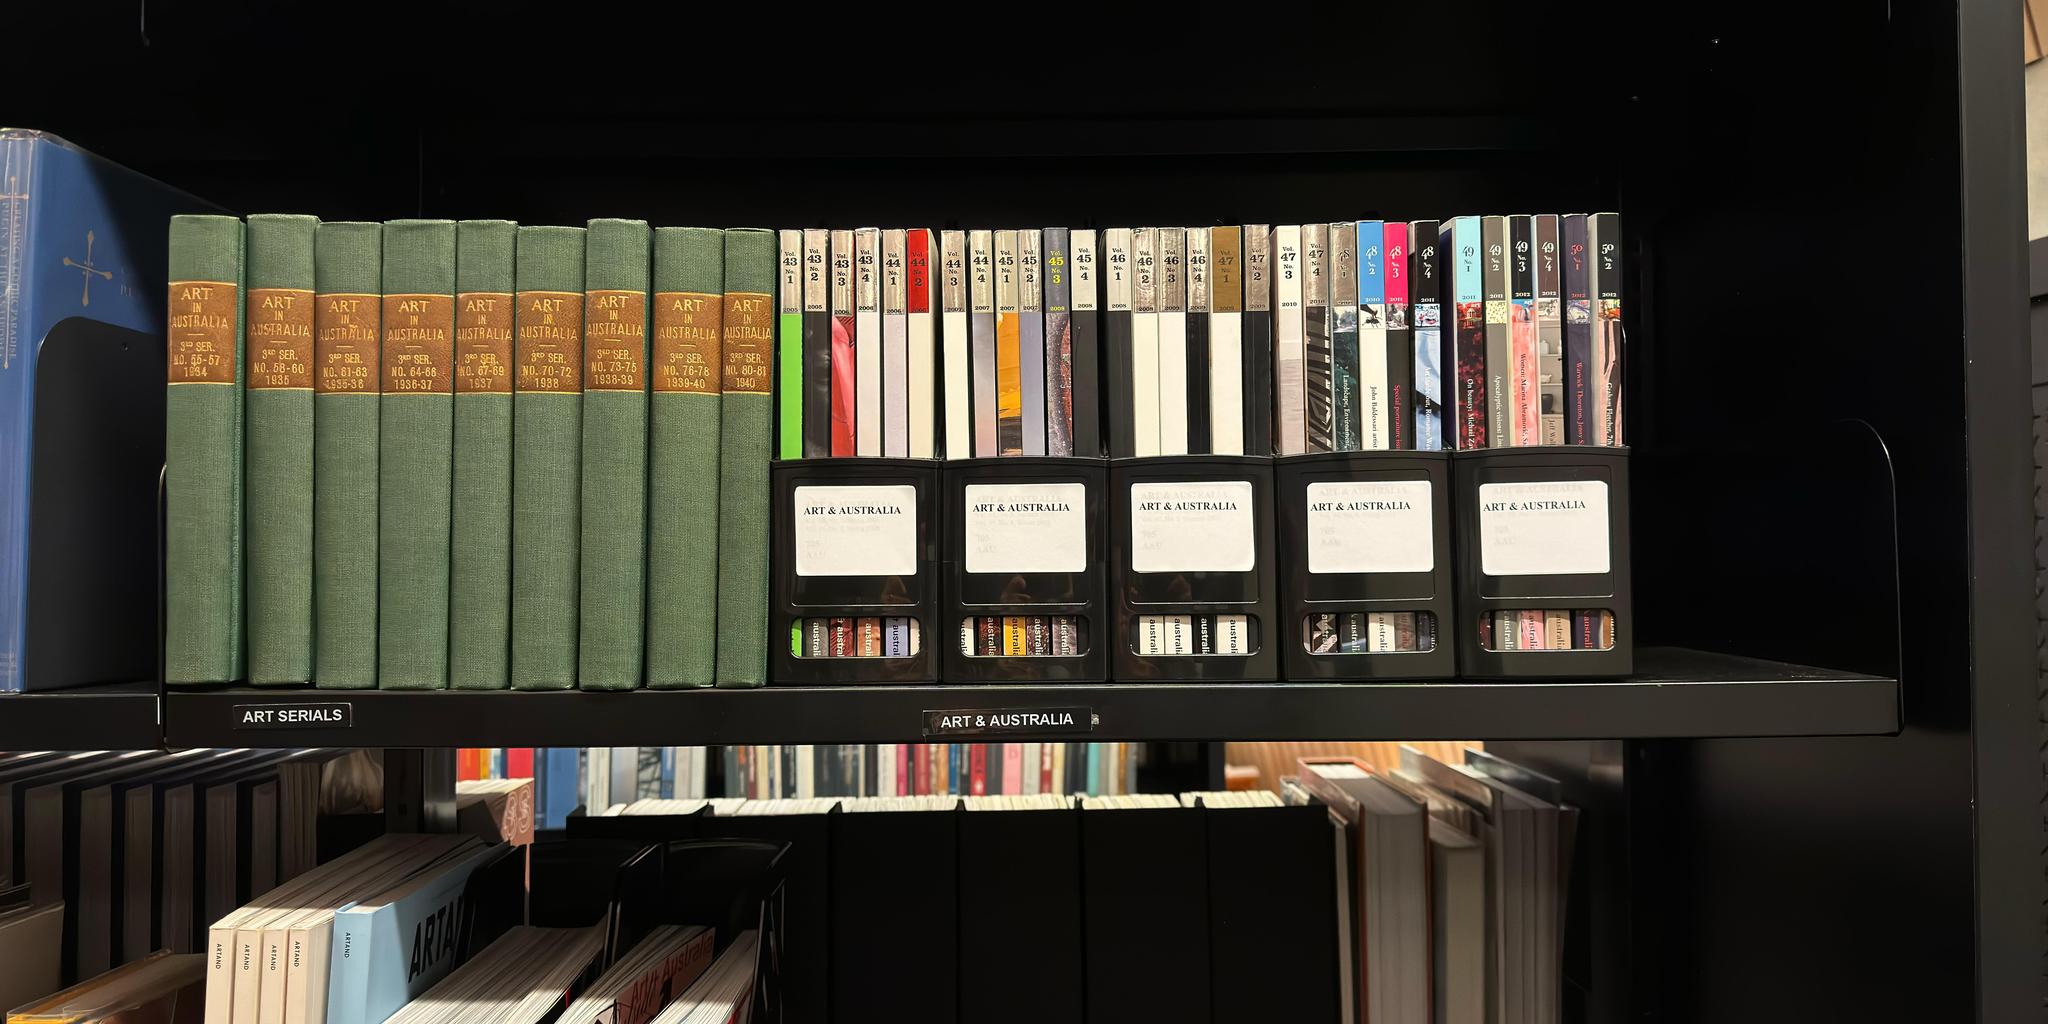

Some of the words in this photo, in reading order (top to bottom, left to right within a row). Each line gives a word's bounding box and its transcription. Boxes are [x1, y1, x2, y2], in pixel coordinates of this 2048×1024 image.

[1462, 246, 1475, 257] 49
[1489, 244, 1502, 256] 49
[1515, 240, 1529, 253] 49
[1541, 242, 1555, 253] 49
[1570, 245, 1583, 256] 50
[1601, 243, 1615, 255] 50
[1281, 252, 1296, 262] 47
[1309, 250, 1324, 258] 47
[1366, 245, 1378, 260] 48
[1389, 245, 1402, 260] 48
[1421, 245, 1434, 260] 48
[783, 257, 798, 267] 43
[807, 255, 822, 264] 43
[858, 256, 873, 265] 43
[886, 259, 901, 268] 44
[910, 259, 926, 267] 44
[946, 260, 961, 268] 44
[973, 257, 989, 265] 44
[998, 257, 1014, 265] 45
[1022, 256, 1037, 265] 45
[1048, 257, 1064, 266] 45
[1077, 254, 1092, 263] 45
[1110, 254, 1126, 263] 46
[1138, 257, 1153, 266] 46
[1164, 257, 1179, 265] 46
[1190, 256, 1206, 265] 46
[1219, 257, 1233, 265] 47
[1250, 254, 1265, 263] 47
[835, 260, 850, 269] 43
[181, 287, 213, 300] ART
[262, 296, 295, 309] ART
[329, 299, 360, 312] ART
[398, 300, 430, 312] ART
[466, 299, 496, 312] ART
[532, 299, 563, 311] ART
[598, 295, 630, 309] ART
[673, 299, 704, 312] ART
[732, 299, 763, 312] ART
[192, 303, 201, 313] IN
[275, 311, 284, 321] IN
[341, 314, 350, 324] IN
[410, 315, 419, 325] IN
[479, 314, 487, 325] IN
[543, 314, 552, 325] IN
[610, 310, 618, 320] IN
[684, 314, 693, 324] IN
[743, 314, 751, 324] IN
[172, 315, 229, 329] AUSTRALIA
[251, 324, 311, 337] AUSTRALIA
[320, 328, 375, 341] AUSTRALIA
[387, 328, 445, 341] AUSTRALIA
[457, 327, 512, 340] AUSTRALIA
[520, 326, 578, 340] AUSTRALIA
[587, 323, 644, 337] AUSTRALIA
[659, 327, 717, 340] AUSTRALIA
[724, 327, 772, 340] AUSTRALIA
[195, 342, 216, 352] SER.
[174, 355, 187, 366] NO.
[279, 350, 298, 360] SER.
[345, 354, 363, 364] SER.
[413, 355, 432, 365] SER.
[480, 354, 499, 364] SER.
[548, 353, 567, 364] SER.
[614, 350, 632, 361] SER.
[686, 354, 705, 364] SER.
[745, 354, 764, 364] SER.
[254, 362, 270, 373] NO.
[323, 367, 338, 378] NO.
[391, 366, 407, 377] NO.
[458, 366, 475, 377] NO.
[523, 366, 539, 377] NO.
[591, 362, 607, 373] NO.
[664, 365, 680, 377] NO.
[726, 364, 741, 376] NO.
[1467, 378, 1473, 388] On
[1494, 375, 1502, 409] Apocalyptic
[804, 506, 825, 514] ART
[839, 506, 901, 514] AUSTRALIA
[973, 504, 995, 512] ART
[997, 503, 1005, 511] &
[1008, 503, 1070, 512] AUSTRALIA
[1139, 502, 1161, 511] ART
[1164, 502, 1172, 511] &
[1174, 502, 1237, 511] AUSTRALIA
[1311, 502, 1333, 511] ART
[1336, 502, 1344, 510] &
[1347, 501, 1411, 510] AUSTRALIA
[1484, 502, 1506, 511] ART
[1509, 503, 1517, 511] &
[1520, 500, 1586, 510] AUSTRALIA
[242, 711, 274, 723] ART
[278, 709, 342, 722] SERIALS
[941, 715, 971, 728] ART
[975, 715, 985, 726] &
[990, 713, 1074, 726] AUSTRALIA
